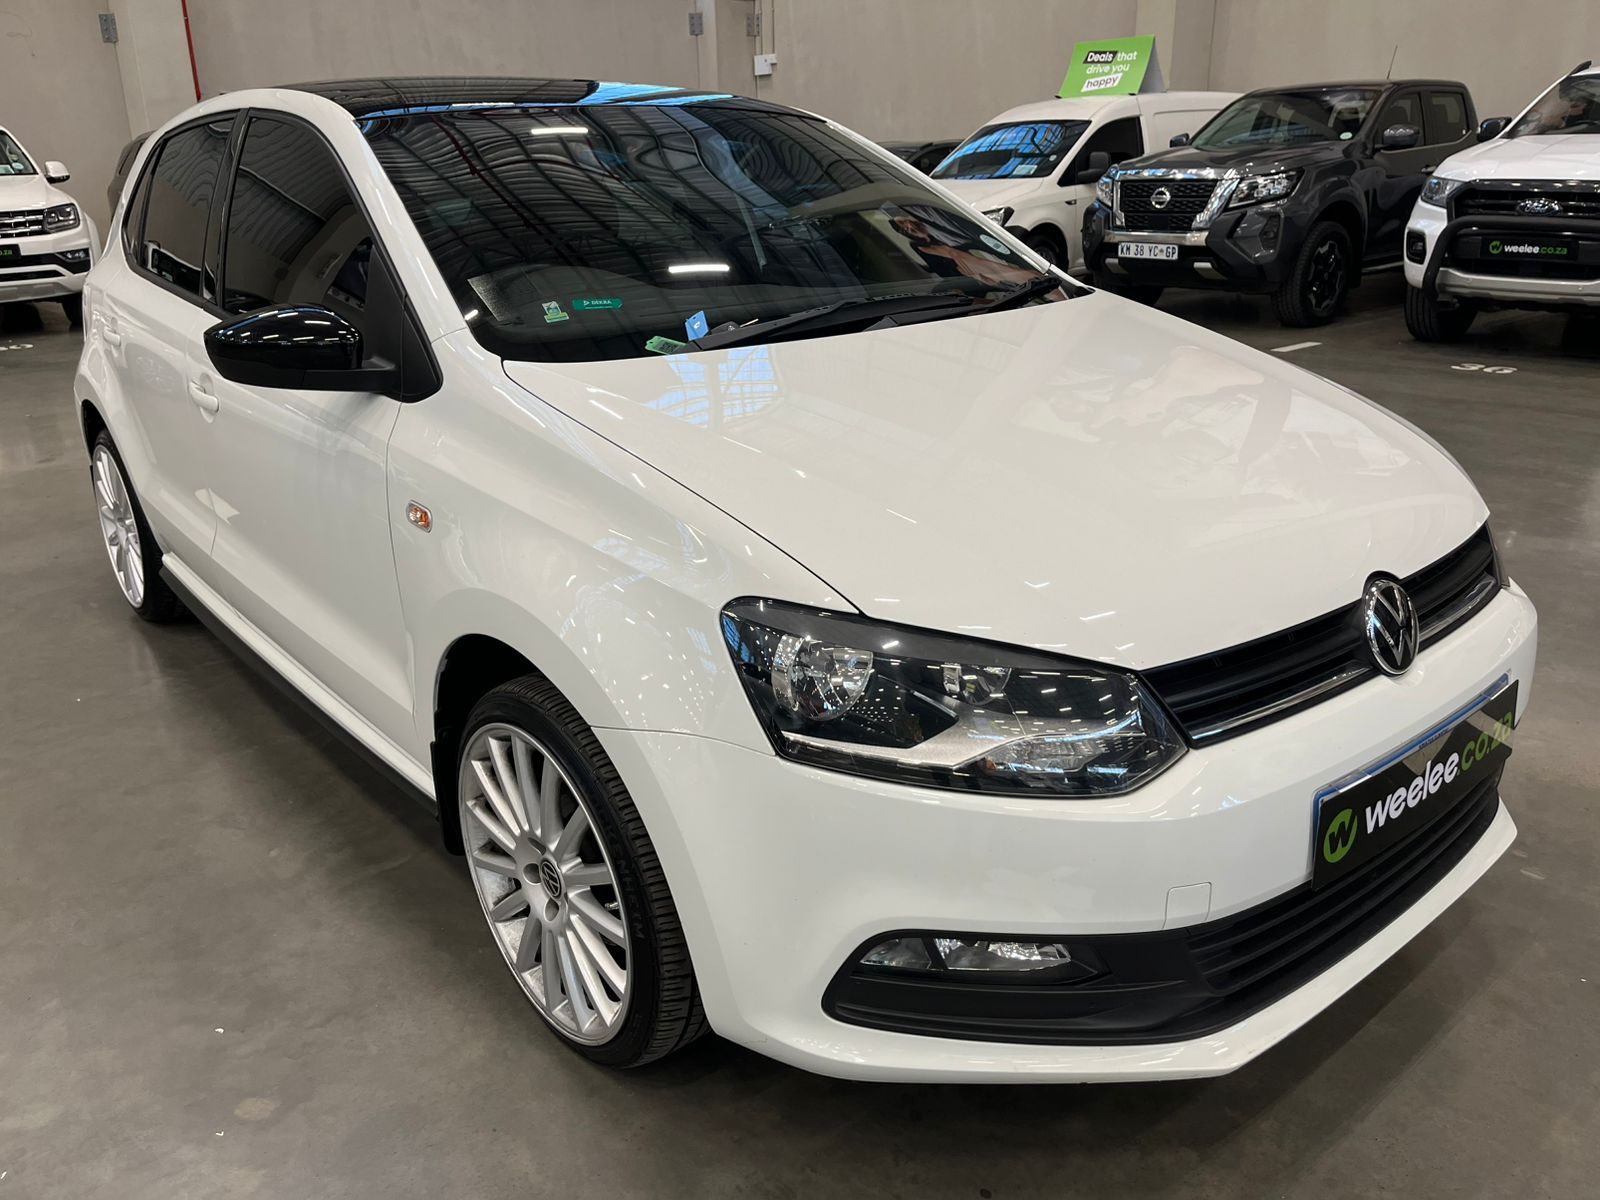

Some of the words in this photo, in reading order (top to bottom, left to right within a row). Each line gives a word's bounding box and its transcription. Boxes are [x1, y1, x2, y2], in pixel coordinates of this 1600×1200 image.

[1086, 52, 1113, 62] Deals
[1116, 51, 1137, 61] that
[1086, 64, 1110, 74] drive
[1111, 63, 1130, 74] you
[1087, 75, 1118, 88] happy
[1134, 244, 1145, 257] 38
[1148, 245, 1159, 257] YC
[1165, 246, 1177, 258] GP
[1504, 243, 1568, 255] weelee.co.za
[1365, 711, 1513, 834] weelee.co.za
